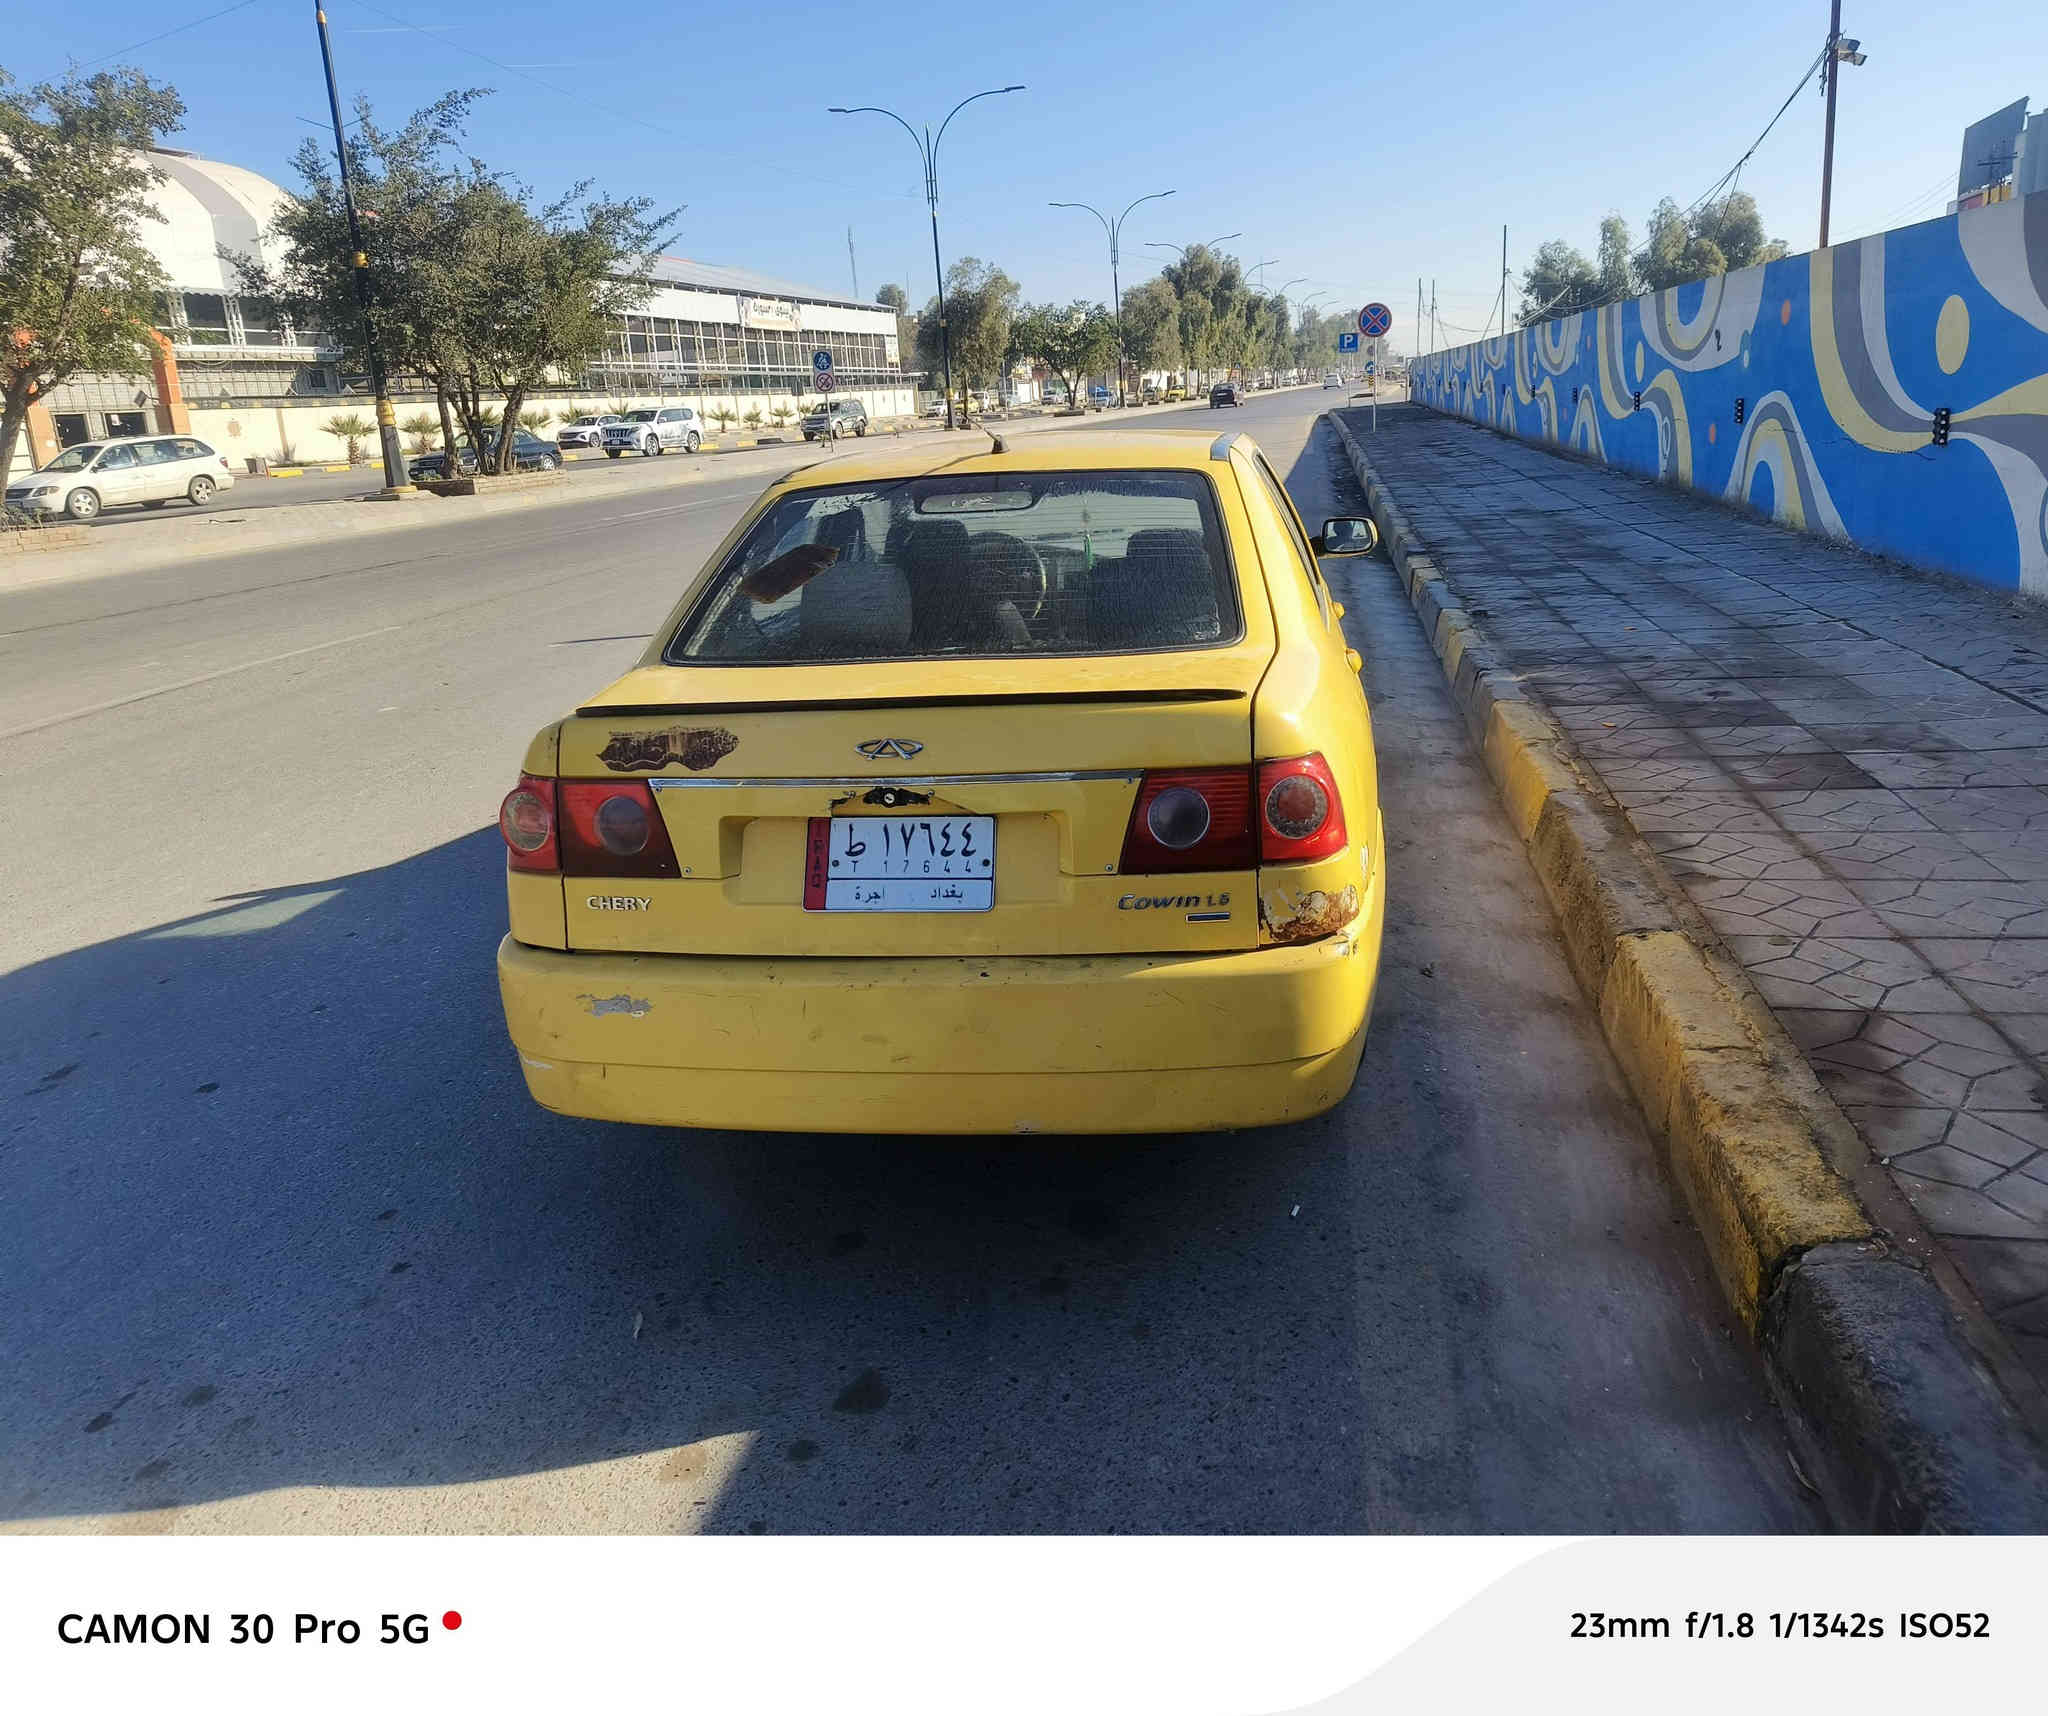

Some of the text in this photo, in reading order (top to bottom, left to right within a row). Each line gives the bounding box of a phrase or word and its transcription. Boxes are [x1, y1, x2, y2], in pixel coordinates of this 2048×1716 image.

[1344, 334, 1353, 347] P
[882, 822, 977, 857] ١٧٦٤٤
[586, 895, 651, 911] CHERY
[930, 884, 963, 904] بغداد
[1118, 893, 1200, 911] Cowin
